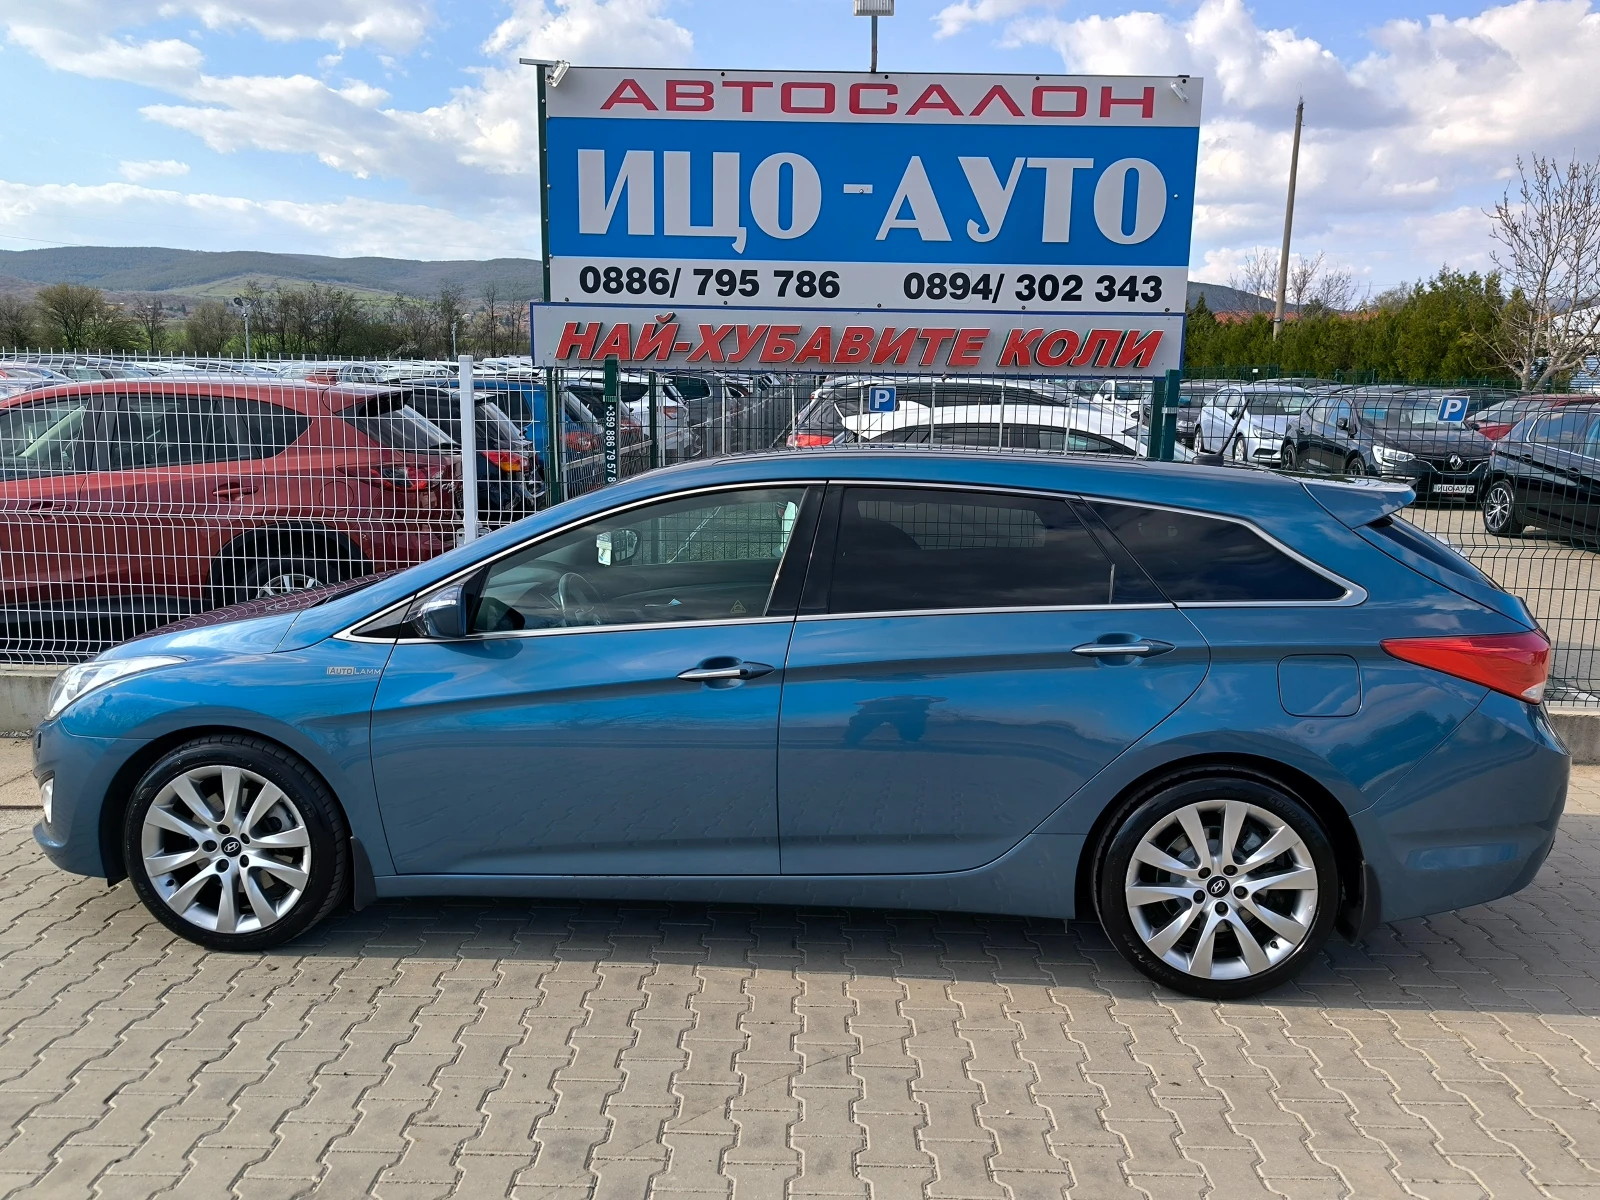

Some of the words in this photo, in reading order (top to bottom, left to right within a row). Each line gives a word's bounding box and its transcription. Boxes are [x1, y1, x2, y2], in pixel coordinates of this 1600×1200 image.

[601, 79, 1156, 119] АВТОСАЛОН
[579, 266, 682, 299] 0886/
[693, 268, 760, 299] 795
[773, 269, 841, 299] 786
[903, 272, 1006, 304] 0894/
[1015, 273, 1084, 303] 302
[1094, 274, 1163, 303] 343
[555, 313, 990, 366] НАЙ-ХУБАВИТЕ
[999, 328, 1164, 368] КОЛИ
[606, 404, 616, 428] +359
[606, 430, 616, 447] 886
[606, 449, 616, 461] 79
[607, 463, 617, 474] 57
